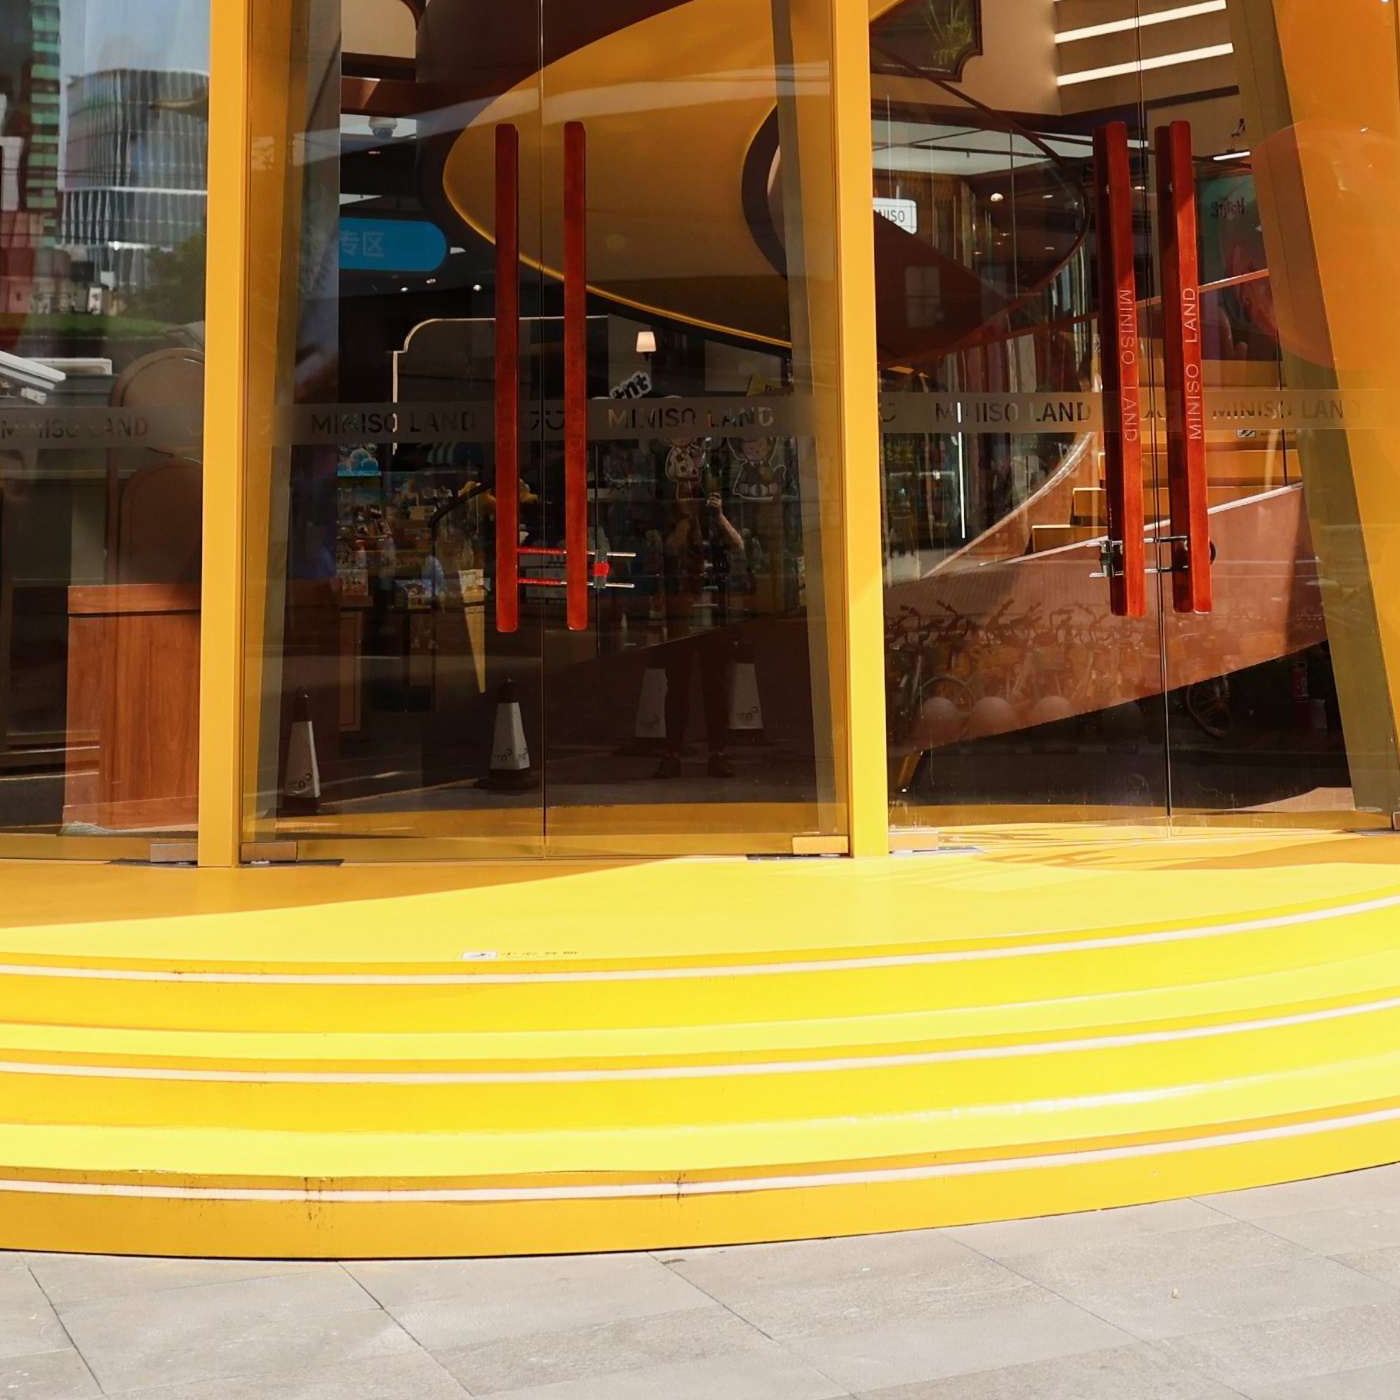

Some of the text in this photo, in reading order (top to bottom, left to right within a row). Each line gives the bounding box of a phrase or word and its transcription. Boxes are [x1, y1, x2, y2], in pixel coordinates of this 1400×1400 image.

[1119, 289, 1137, 442] MINISO LAND
[1184, 287, 1202, 440] MINISO LAND
